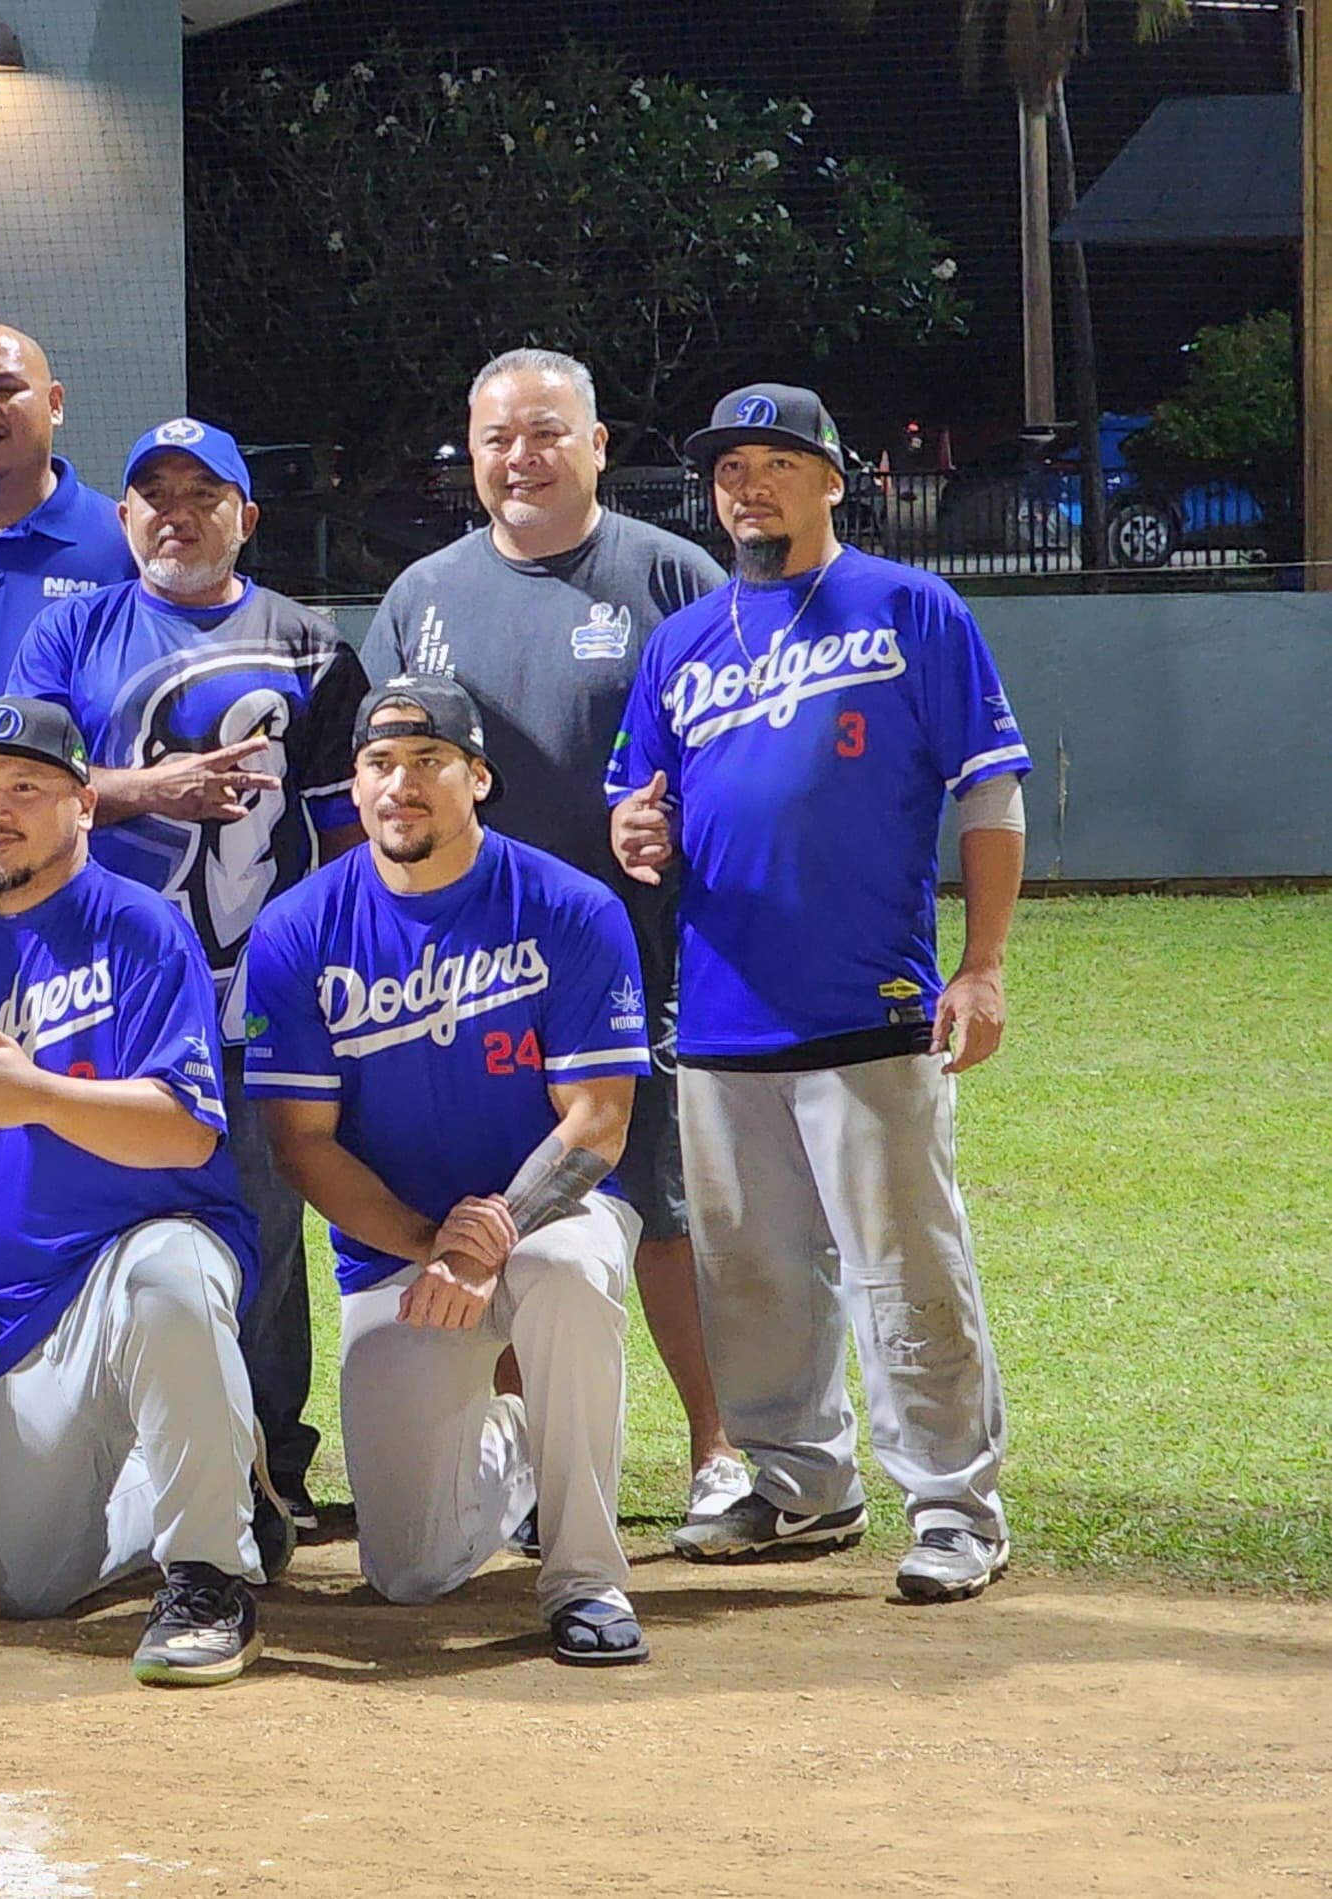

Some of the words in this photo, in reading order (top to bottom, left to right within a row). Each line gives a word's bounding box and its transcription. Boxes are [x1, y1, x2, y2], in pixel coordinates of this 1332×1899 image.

[736, 394, 777, 428] D
[662, 628, 907, 730] Dodgers
[837, 712, 866, 757] 3
[317, 939, 550, 1047] Dodgers
[483, 1027, 542, 1074] 24
